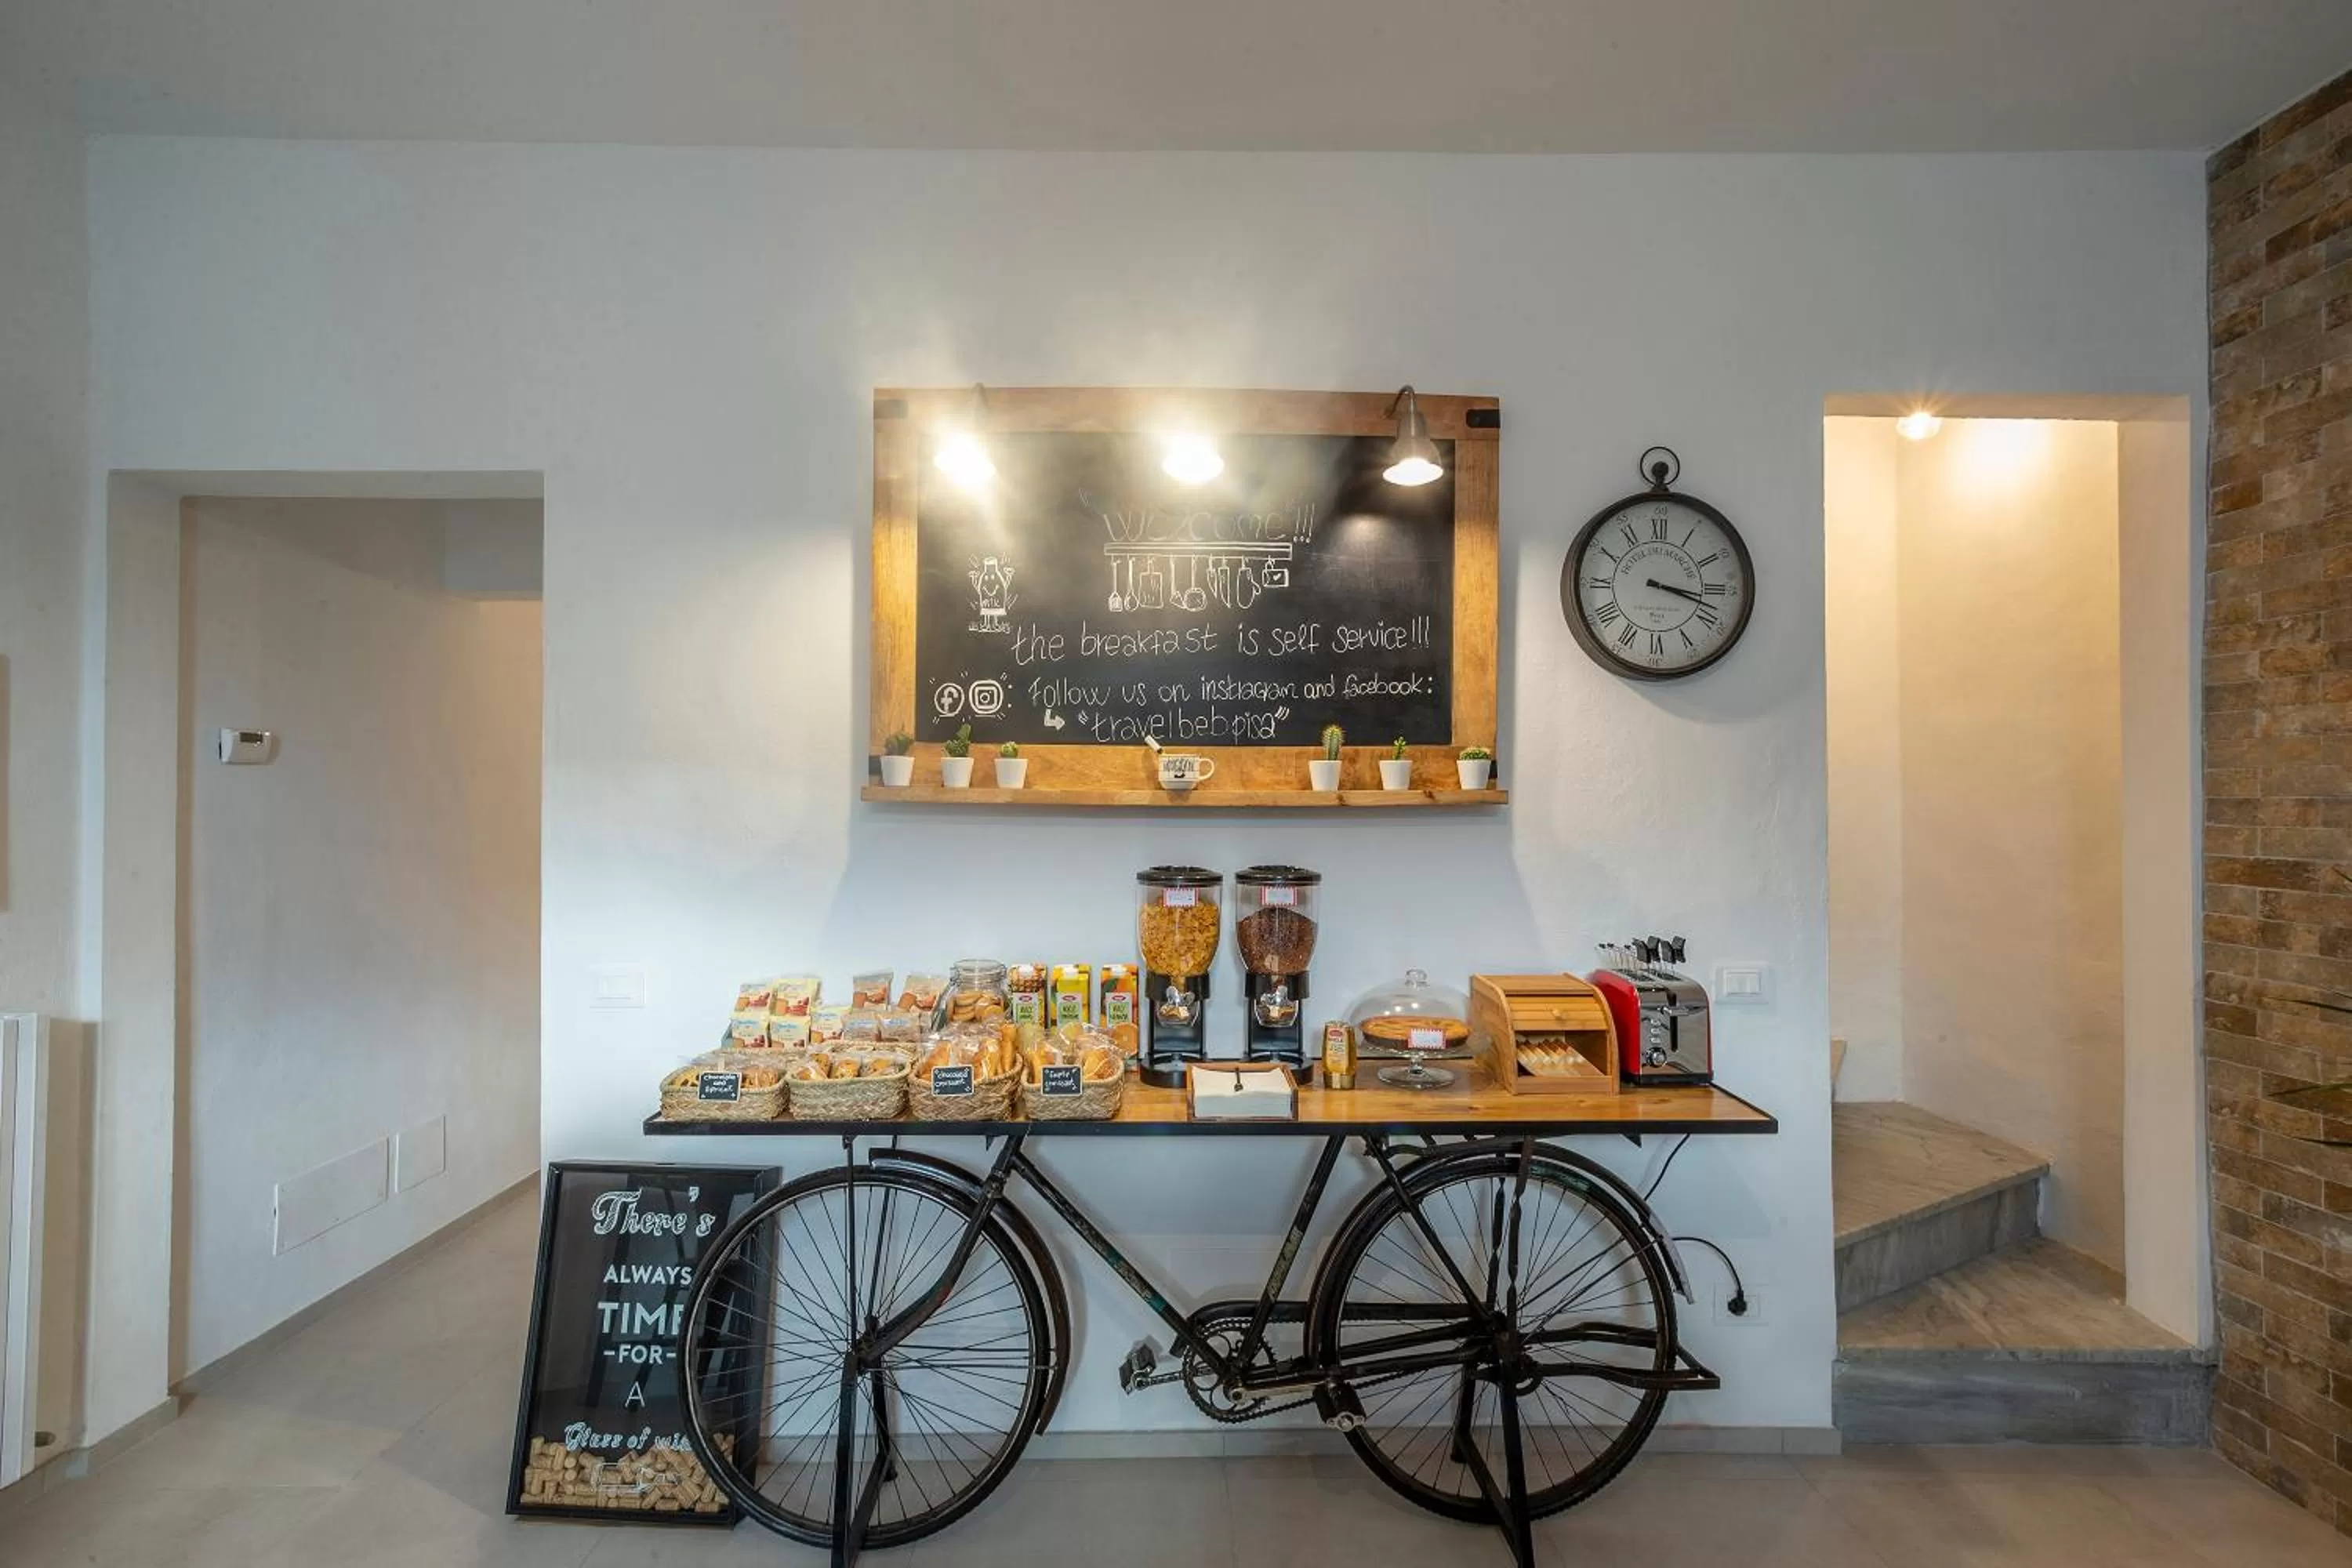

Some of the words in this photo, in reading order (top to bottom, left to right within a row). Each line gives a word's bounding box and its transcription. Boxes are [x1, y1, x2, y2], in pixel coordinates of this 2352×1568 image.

[1649, 518, 1668, 540] XII
[1704, 583, 1726, 596] III
[1011, 622, 1065, 666] the
[1080, 620, 1218, 657] breakfast
[1237, 622, 1260, 656] is
[1268, 623, 1321, 656] self
[1122, 682, 1148, 706] us
[1157, 683, 1191, 704] on
[1200, 673, 1299, 702] instagram
[1304, 673, 1335, 700] and
[1342, 672, 1433, 700] facebook:
[591, 1185, 716, 1237] There's
[603, 1263, 693, 1286] ALWAYS
[624, 1381, 646, 1409] A
[564, 1421, 623, 1451] Glass
[626, 1425, 652, 1450] of
[655, 1432, 693, 1451] win
